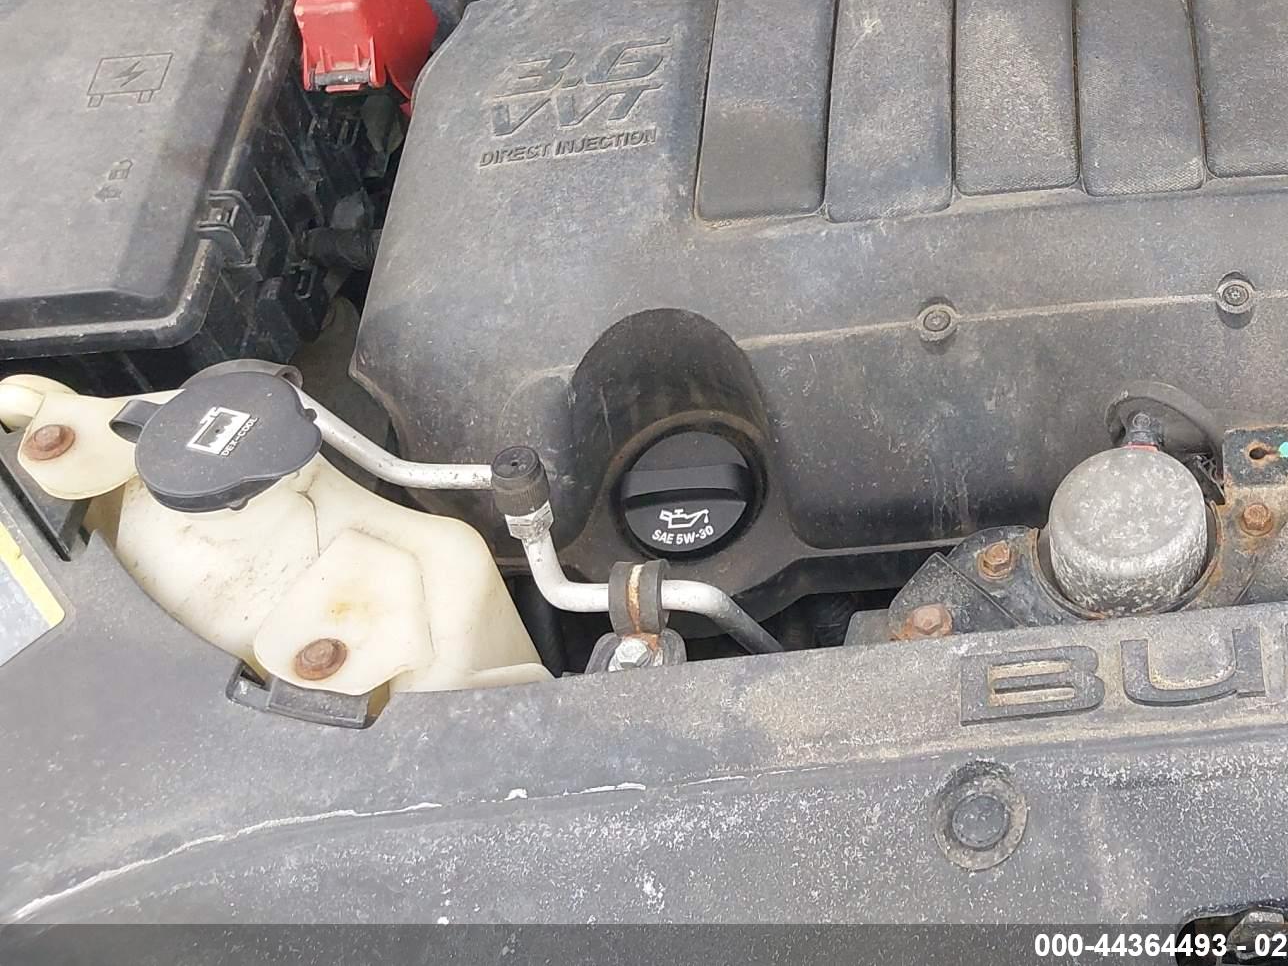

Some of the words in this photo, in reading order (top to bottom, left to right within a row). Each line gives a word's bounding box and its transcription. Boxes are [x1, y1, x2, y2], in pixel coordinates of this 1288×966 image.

[493, 37, 672, 99] 3.6
[493, 83, 665, 137] VVT
[479, 143, 552, 168] DIRECT
[554, 128, 657, 156] INJECTION
[220, 417, 258, 456] DEX-COOL
[652, 530, 674, 544] SAE
[676, 525, 714, 545] 5W-30
